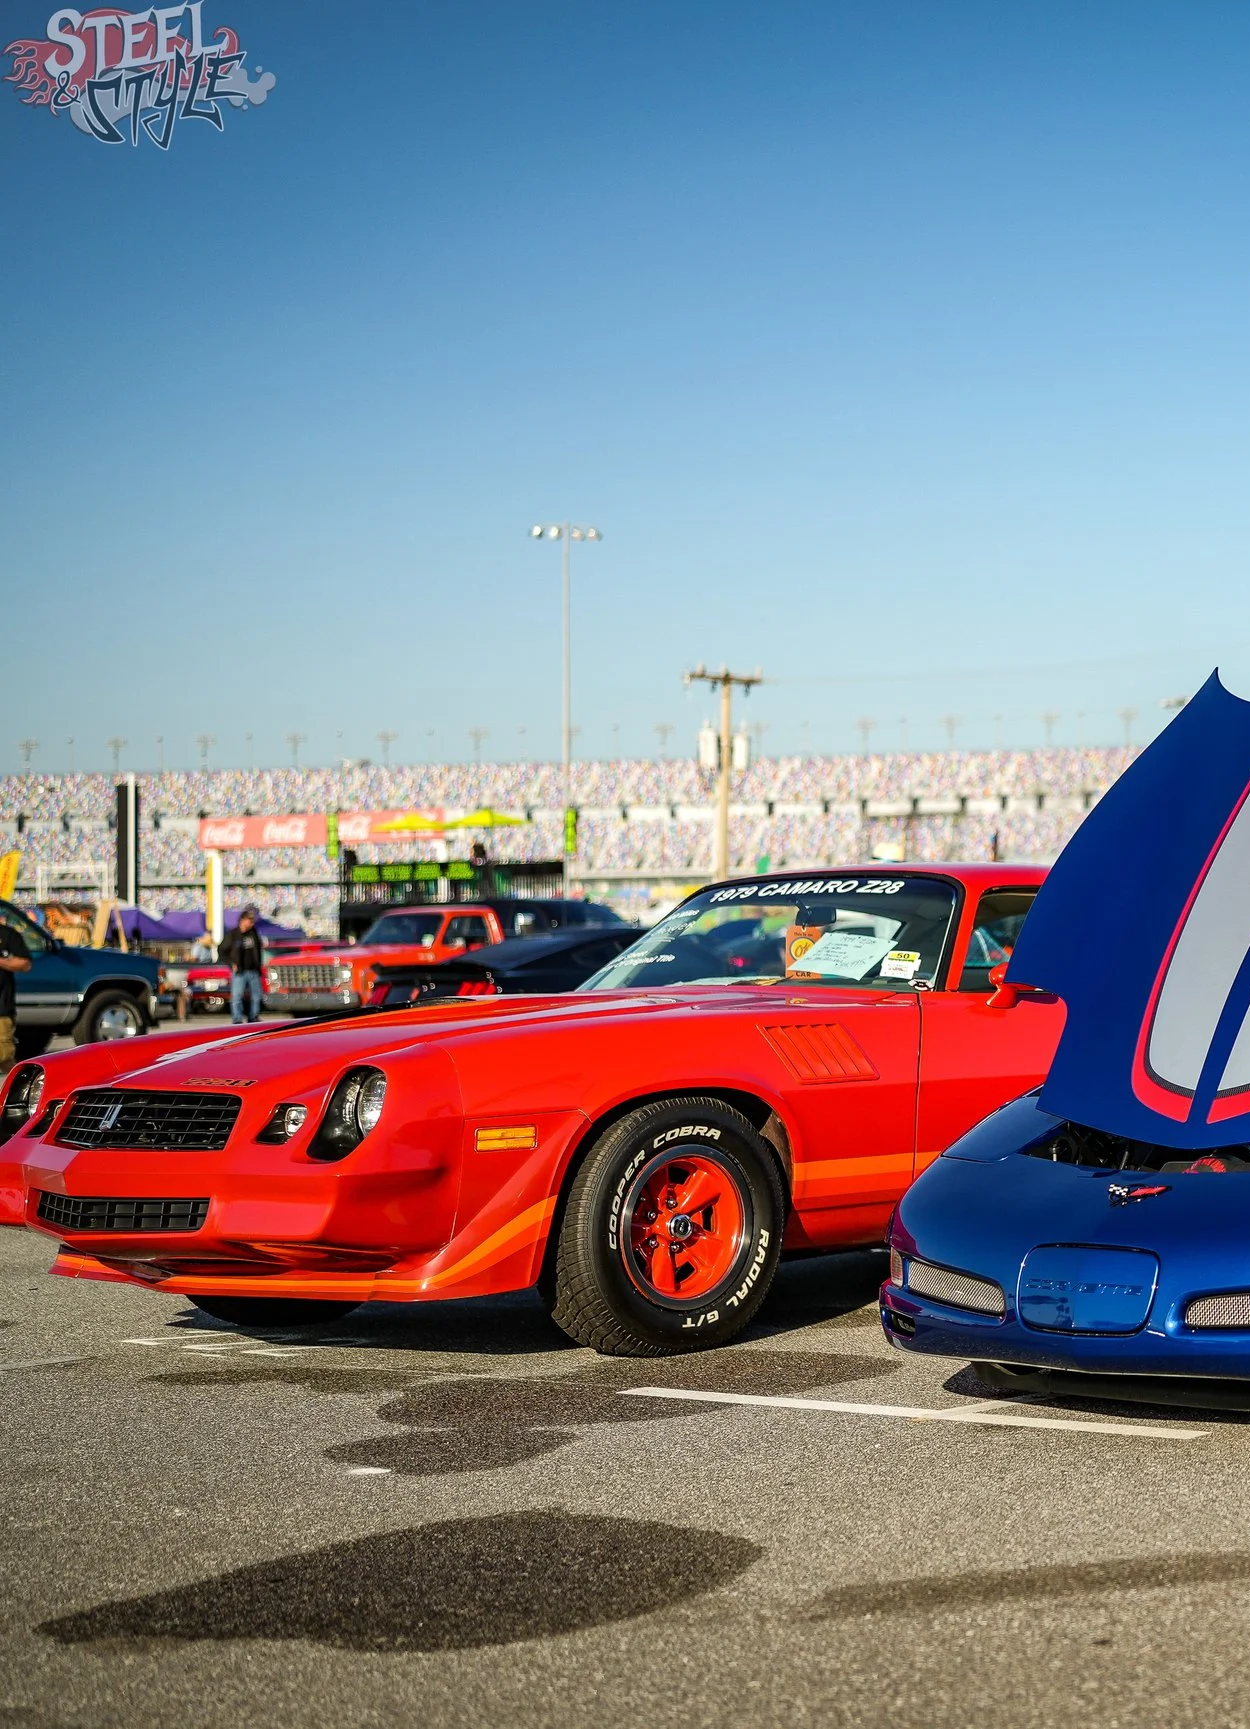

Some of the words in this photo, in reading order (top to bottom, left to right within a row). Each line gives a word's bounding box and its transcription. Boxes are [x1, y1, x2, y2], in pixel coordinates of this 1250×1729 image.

[710, 886, 758, 903] 1979
[758, 880, 859, 897] CAMARO
[856, 880, 905, 894] Z28
[896, 952, 910, 960] 50
[608, 1150, 647, 1250] COOPER
[653, 1124, 722, 1149] COBRA
[726, 1228, 770, 1308] RADIAL
[682, 1309, 720, 1330] G/T
